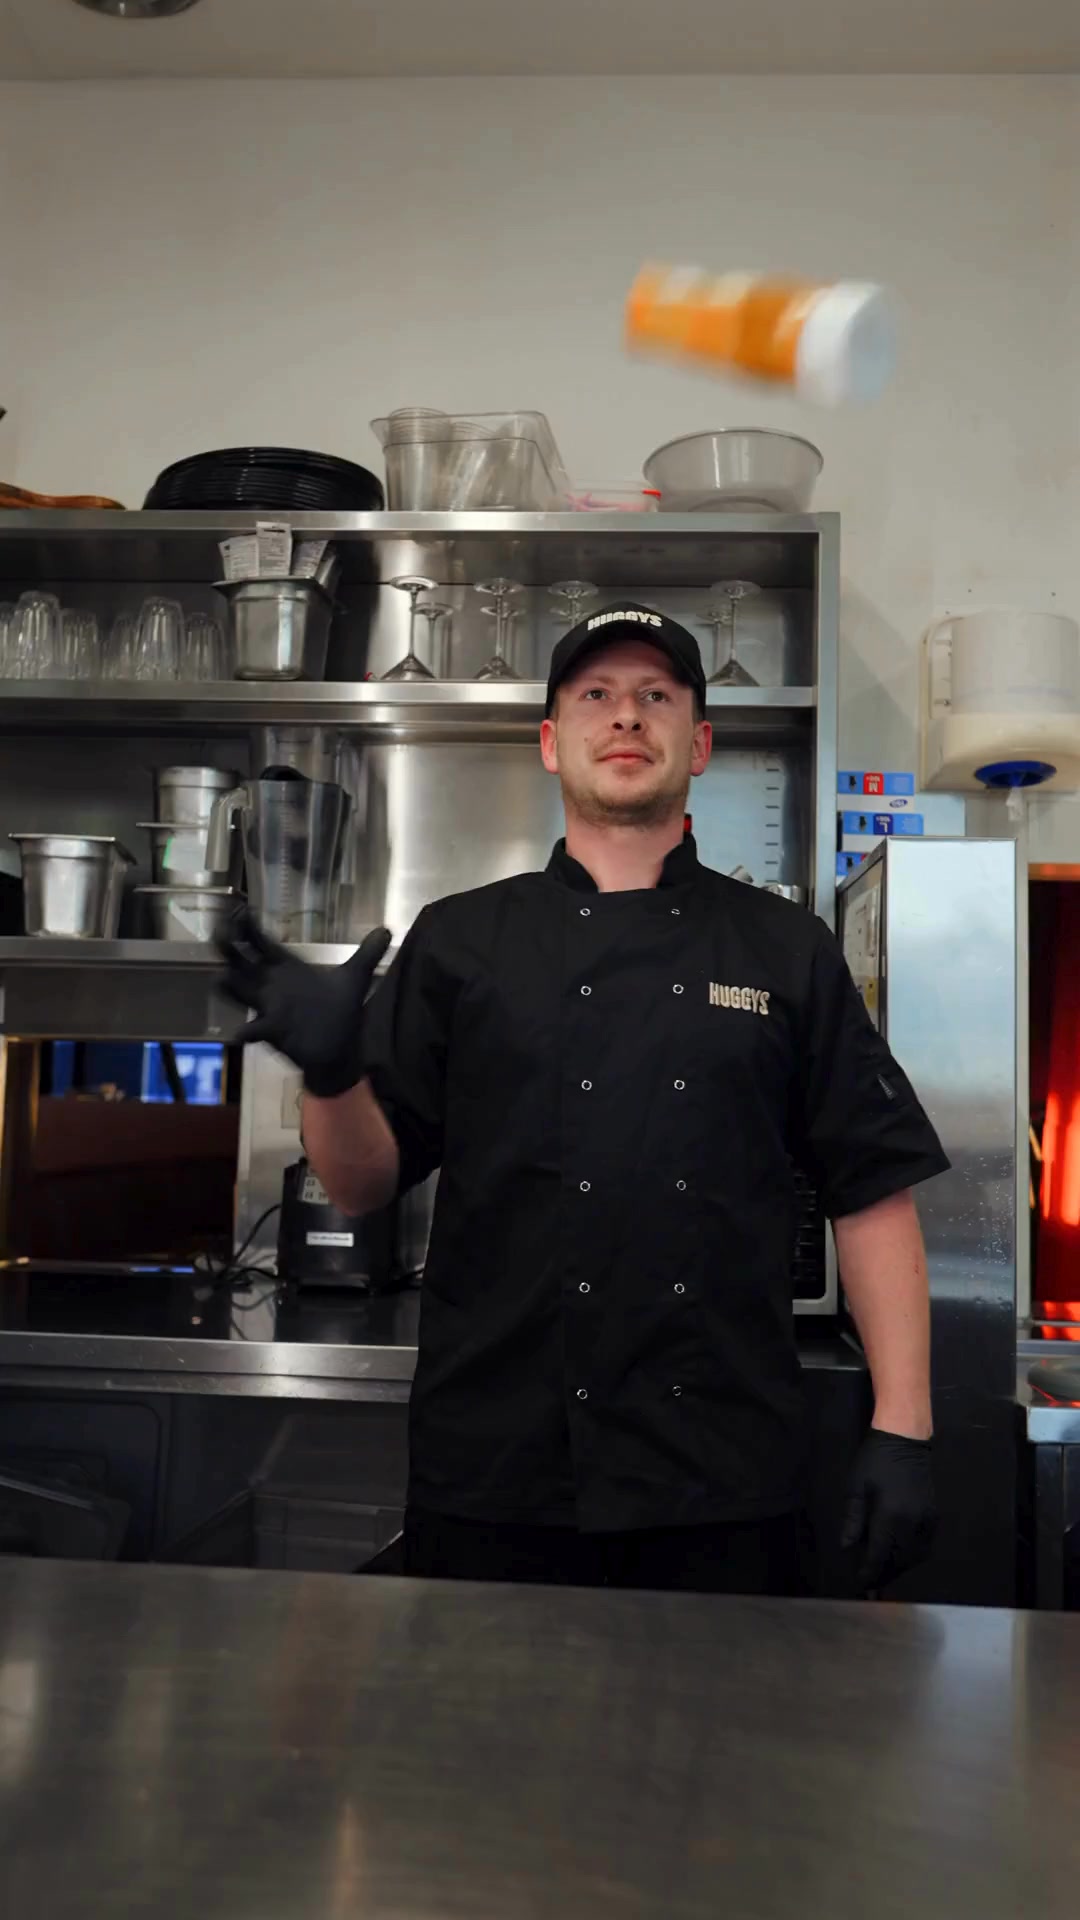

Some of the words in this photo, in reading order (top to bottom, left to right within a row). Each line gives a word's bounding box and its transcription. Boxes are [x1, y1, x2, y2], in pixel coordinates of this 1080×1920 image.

[587, 610, 663, 631] HUGGYS
[869, 782, 878, 792] M
[880, 822, 888, 833] L
[708, 981, 771, 1016] HUGGYS
